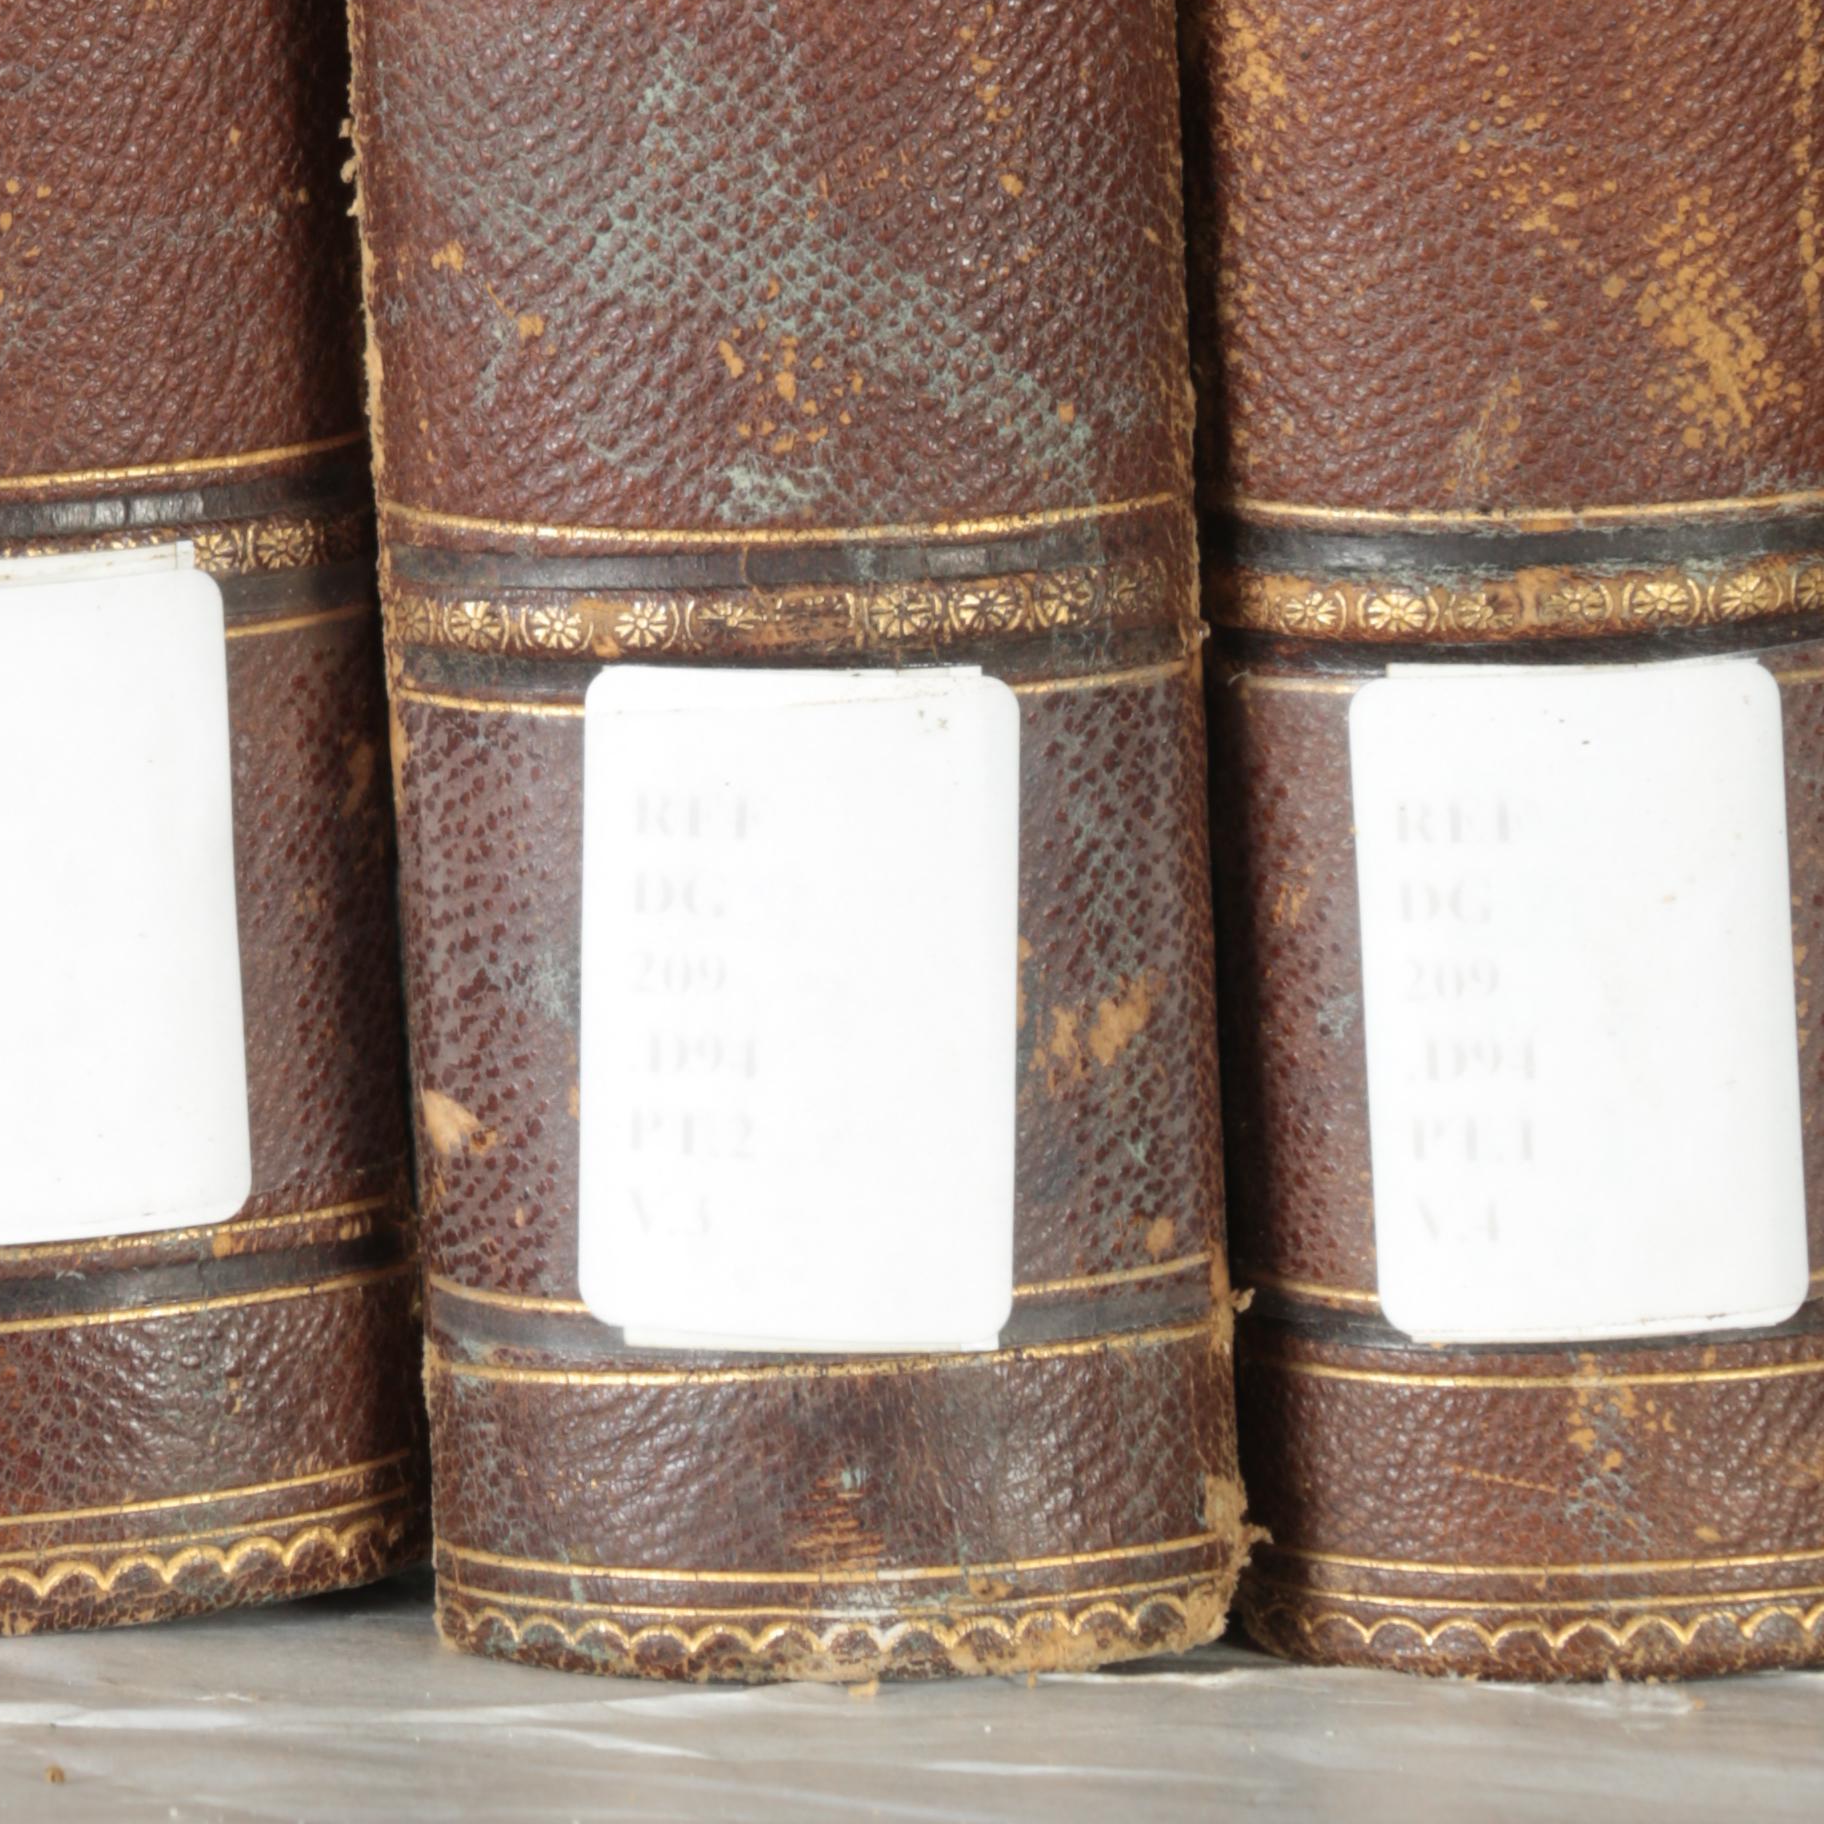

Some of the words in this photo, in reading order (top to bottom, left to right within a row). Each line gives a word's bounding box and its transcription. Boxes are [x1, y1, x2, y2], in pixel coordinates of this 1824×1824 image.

[632, 869, 728, 919] DG
[1398, 875, 1493, 924] DG
[630, 948, 729, 996] 209
[1401, 954, 1502, 1002] 209
